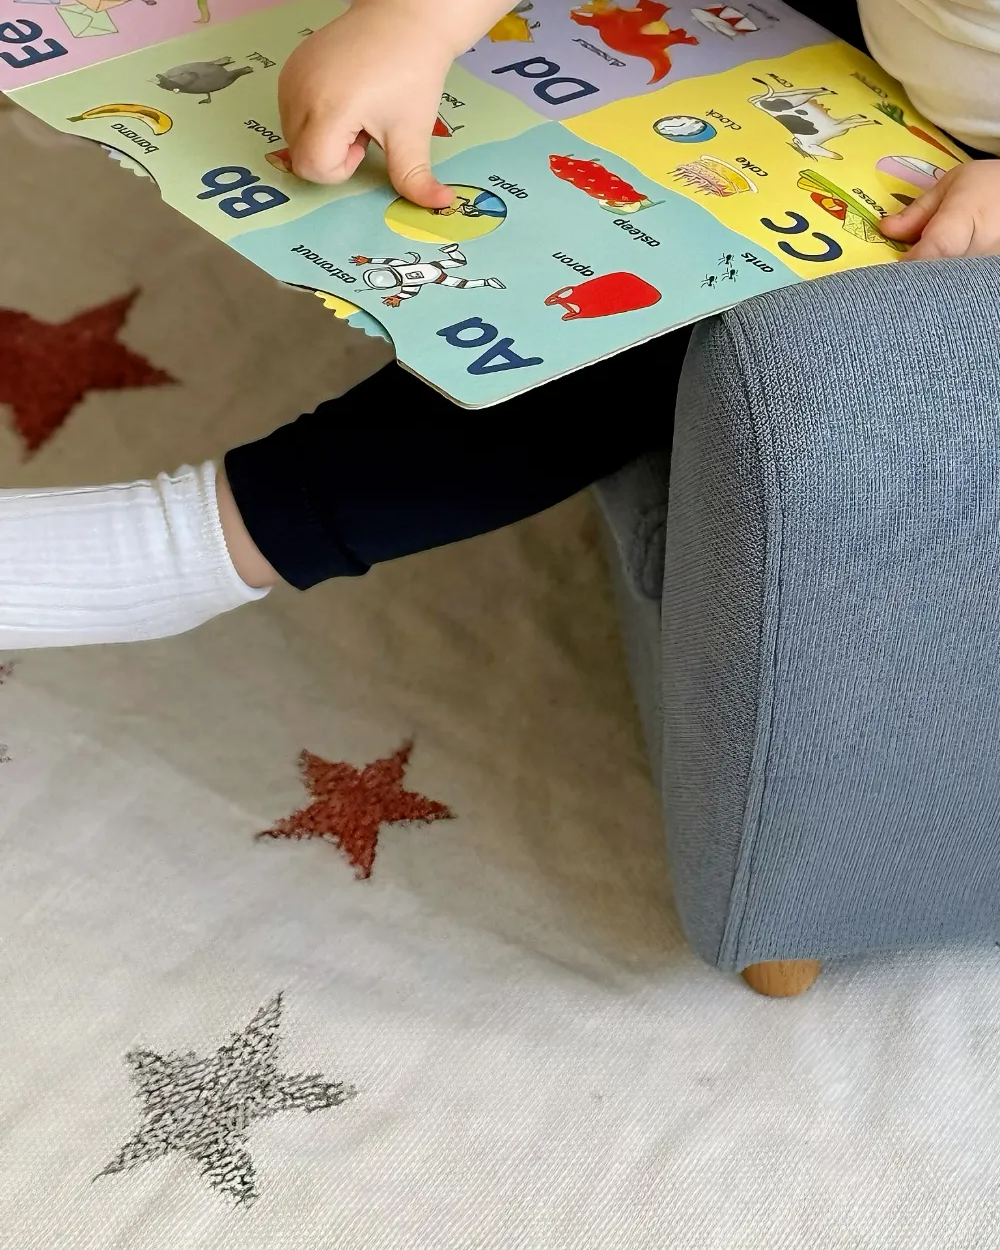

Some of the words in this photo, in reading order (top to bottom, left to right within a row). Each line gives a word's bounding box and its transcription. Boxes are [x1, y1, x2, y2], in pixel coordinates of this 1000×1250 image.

[0, 18, 69, 69] Ee
[491, 56, 600, 105] Dd
[243, 119, 282, 143] boots
[705, 108, 742, 132] clock
[110, 122, 160, 154] banana
[735, 156, 769, 178] cake
[196, 165, 291, 219] Bb
[487, 174, 530, 200] apple
[852, 187, 888, 219] heese
[612, 217, 661, 248] asleep
[760, 210, 844, 263] Cc
[290, 244, 356, 285] astronaut
[551, 250, 596, 278] apron
[740, 251, 774, 274] ants
[436, 316, 545, 376] Aa
